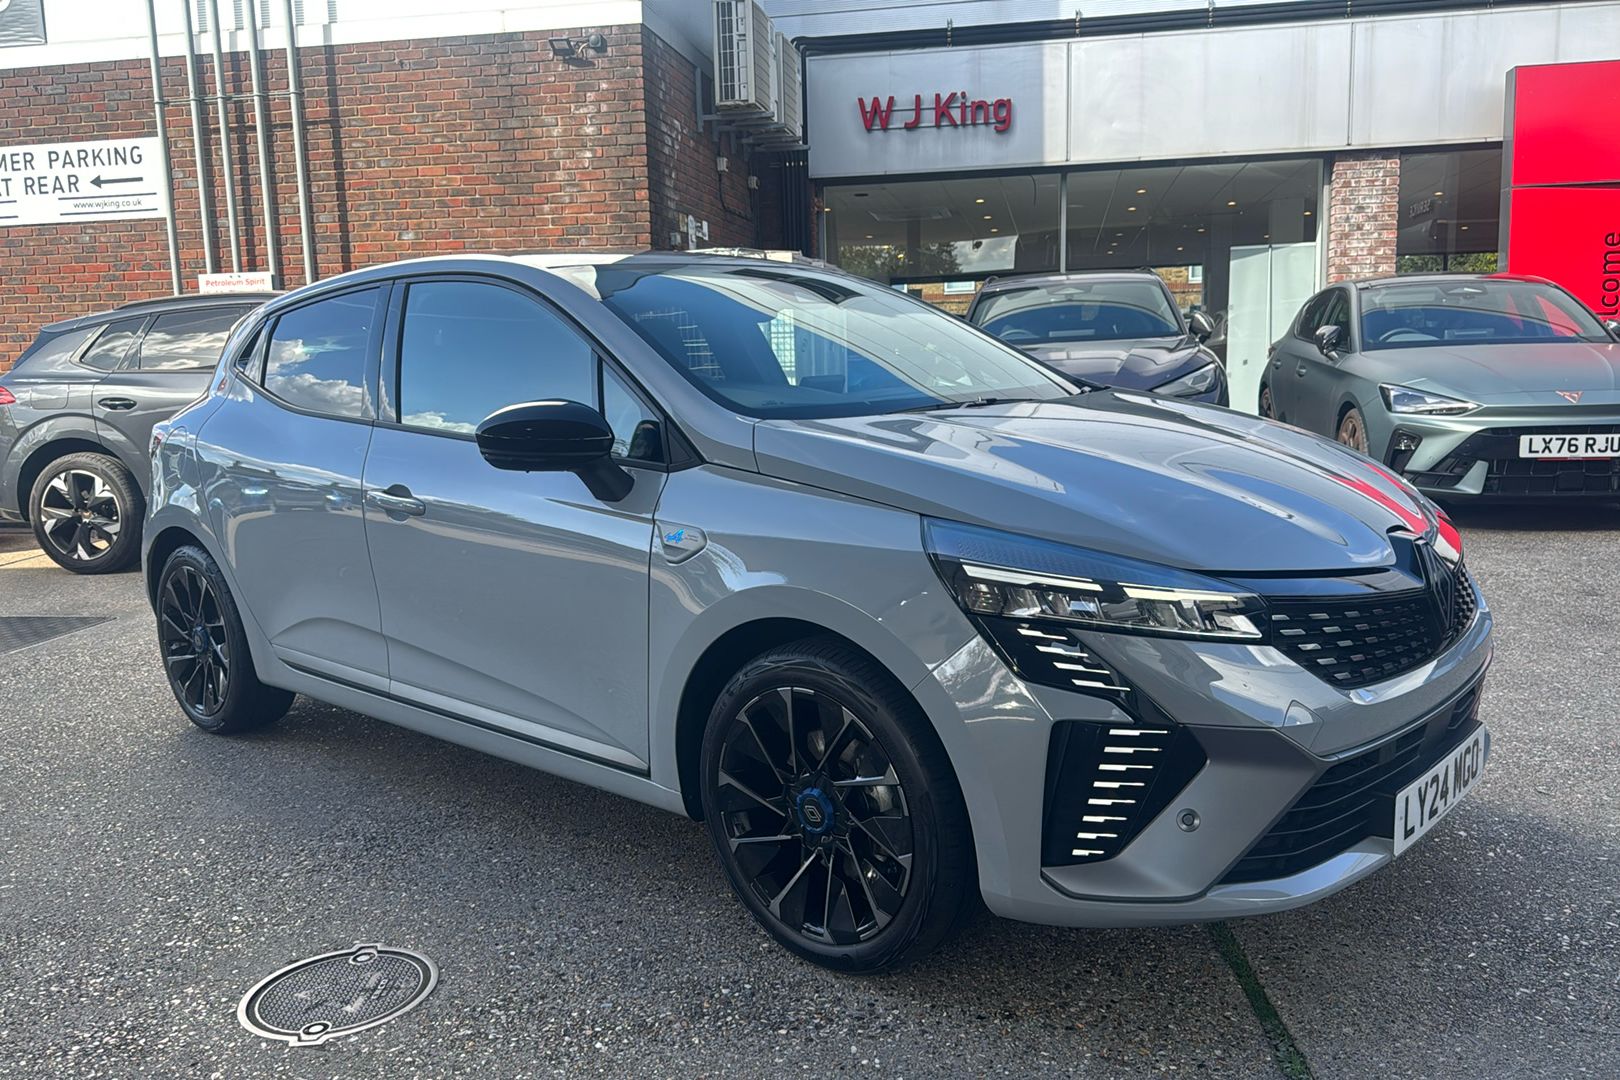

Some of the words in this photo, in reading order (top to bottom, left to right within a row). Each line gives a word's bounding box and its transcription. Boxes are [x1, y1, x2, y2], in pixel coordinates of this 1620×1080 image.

[857, 95, 895, 131] W
[904, 94, 921, 129] J
[935, 91, 1012, 132] King
[48, 146, 143, 169] PARKING
[0, 177, 12, 196] T
[24, 174, 80, 195] REAR
[205, 279, 244, 287] Petroleum
[245, 278, 265, 286] Spirit
[1596, 232, 1620, 318] lcome
[1528, 437, 1579, 454] LX76
[1585, 436, 1620, 454] RJU
[1404, 764, 1449, 840] LY24
[1453, 737, 1480, 799] MGO
